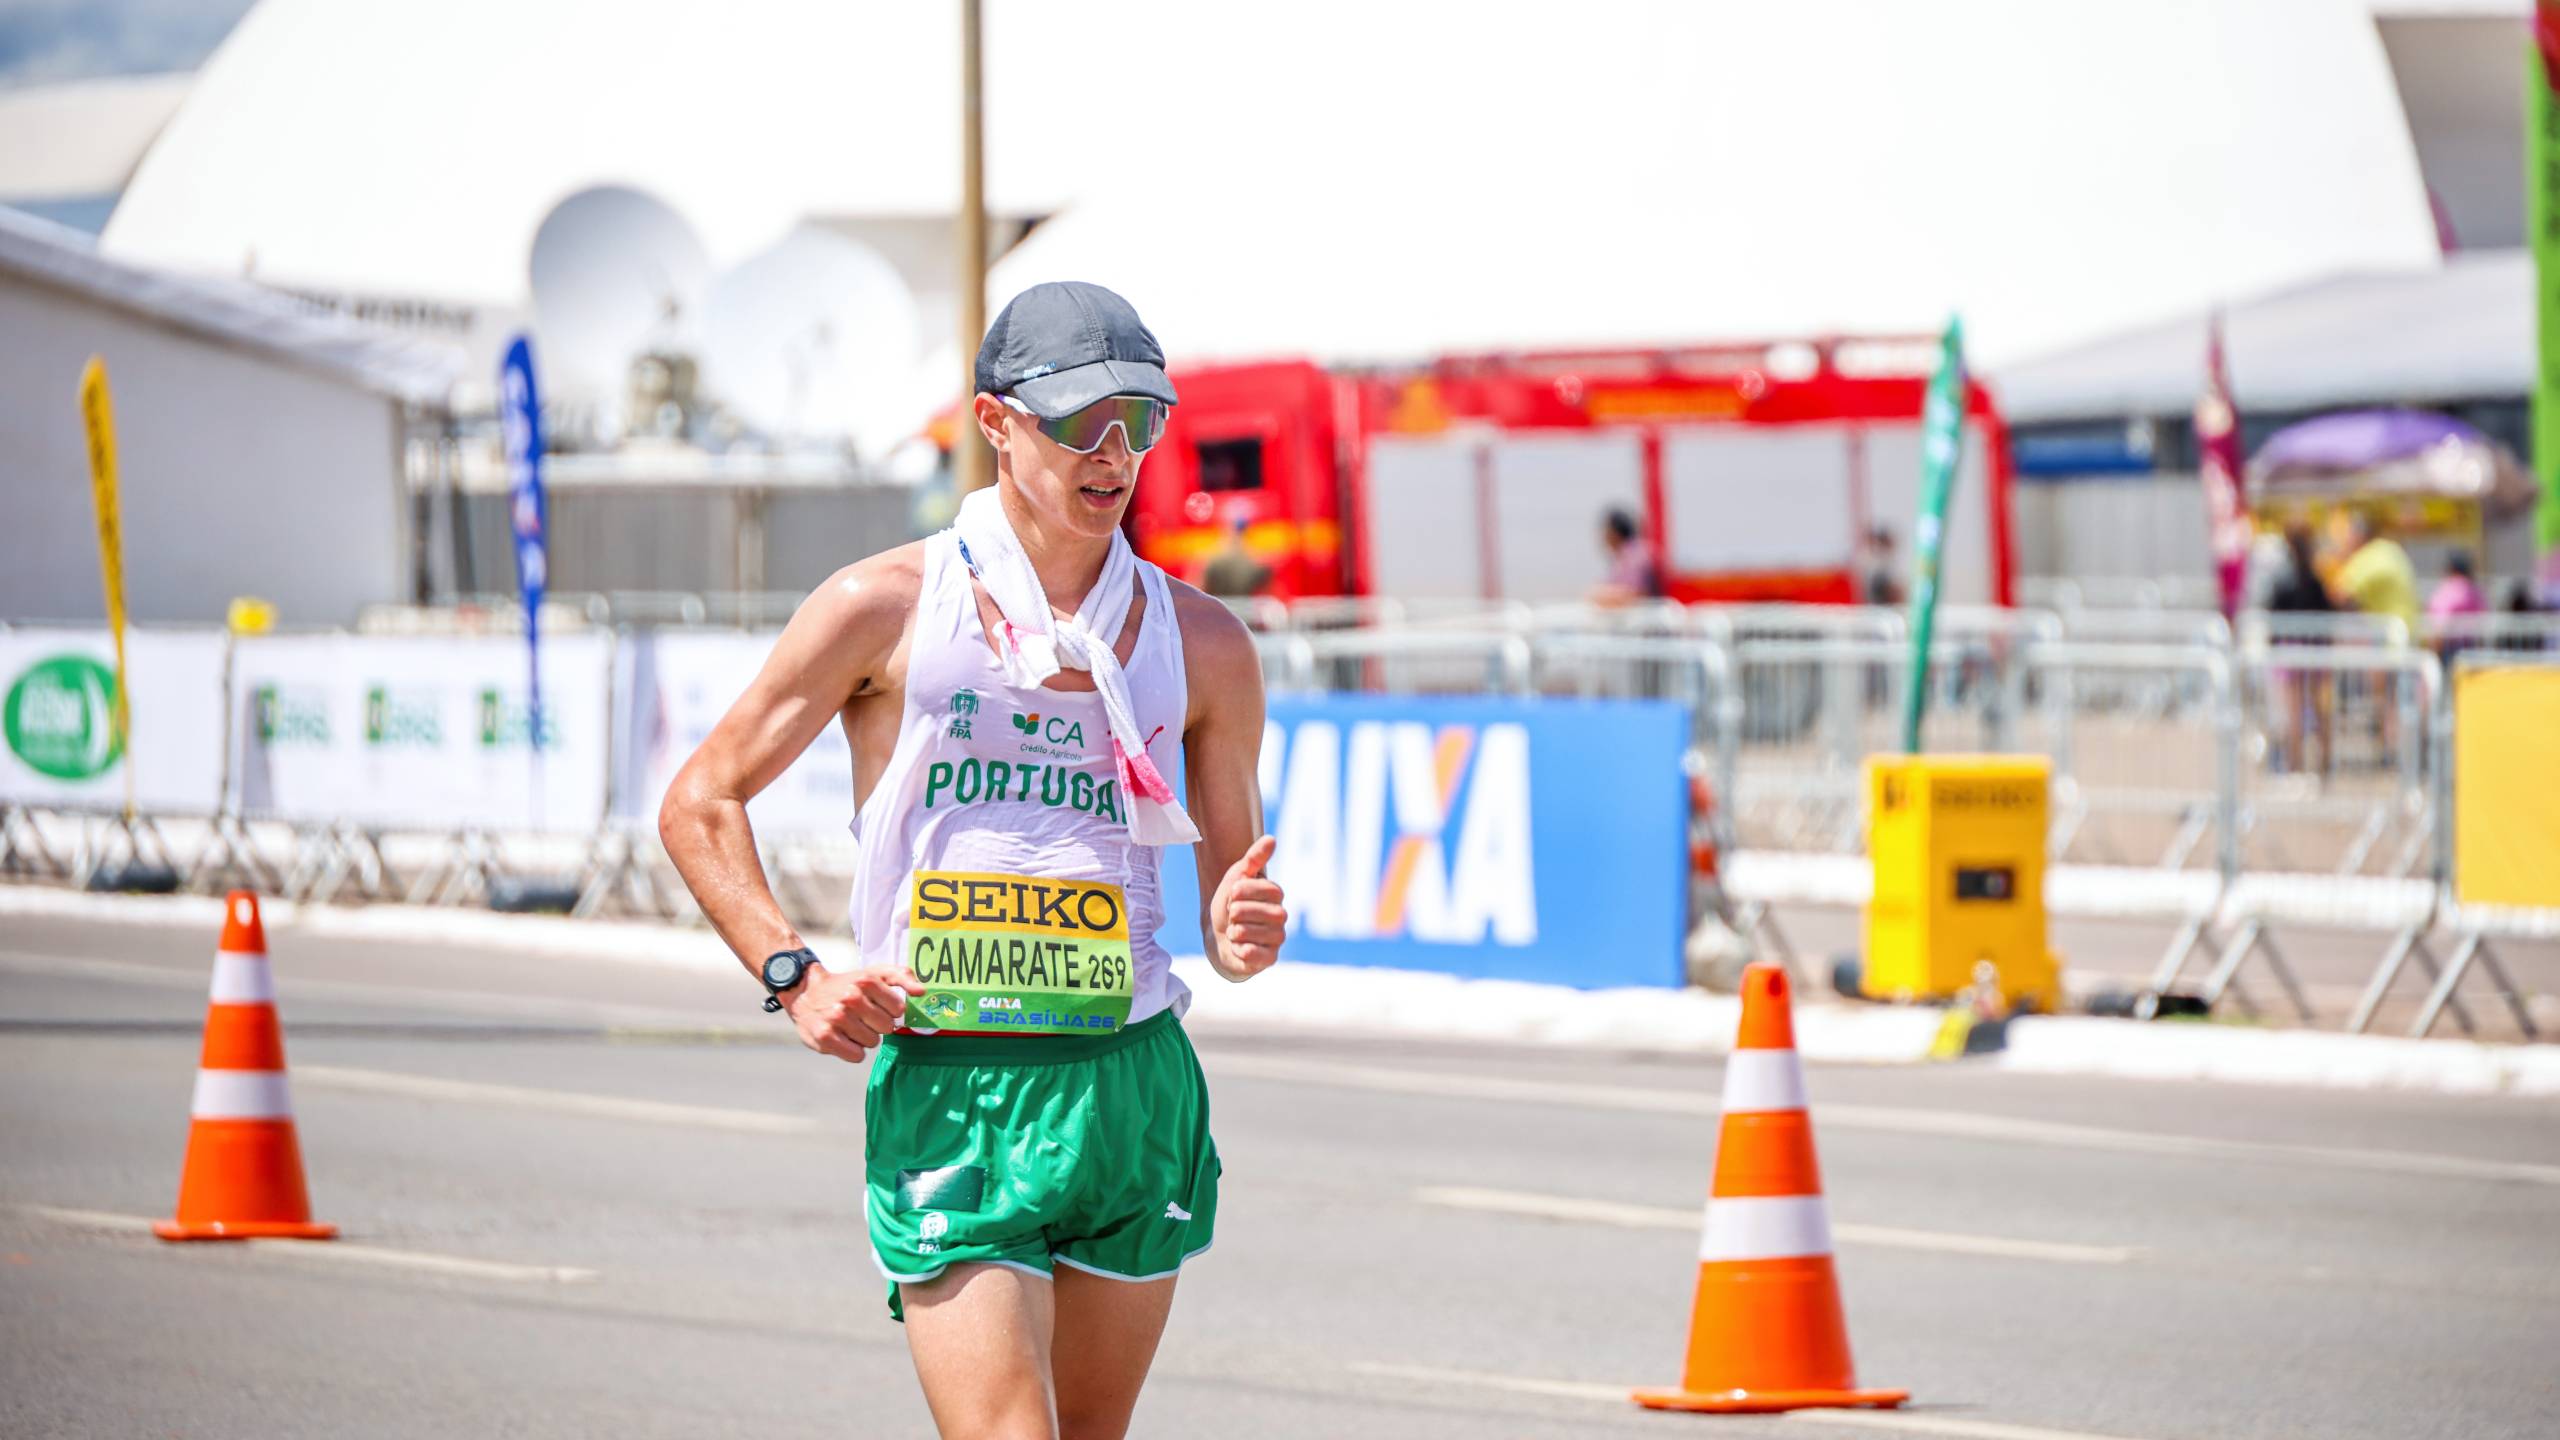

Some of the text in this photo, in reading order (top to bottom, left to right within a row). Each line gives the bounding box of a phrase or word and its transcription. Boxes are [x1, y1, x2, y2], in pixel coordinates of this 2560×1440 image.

[949, 728, 972, 740] FPA
[1045, 717, 1085, 748] CA
[918, 879, 1118, 931] SEIKO
[914, 936, 1126, 990] CAMARATE 269
[978, 996, 1022, 1009] CAIXA
